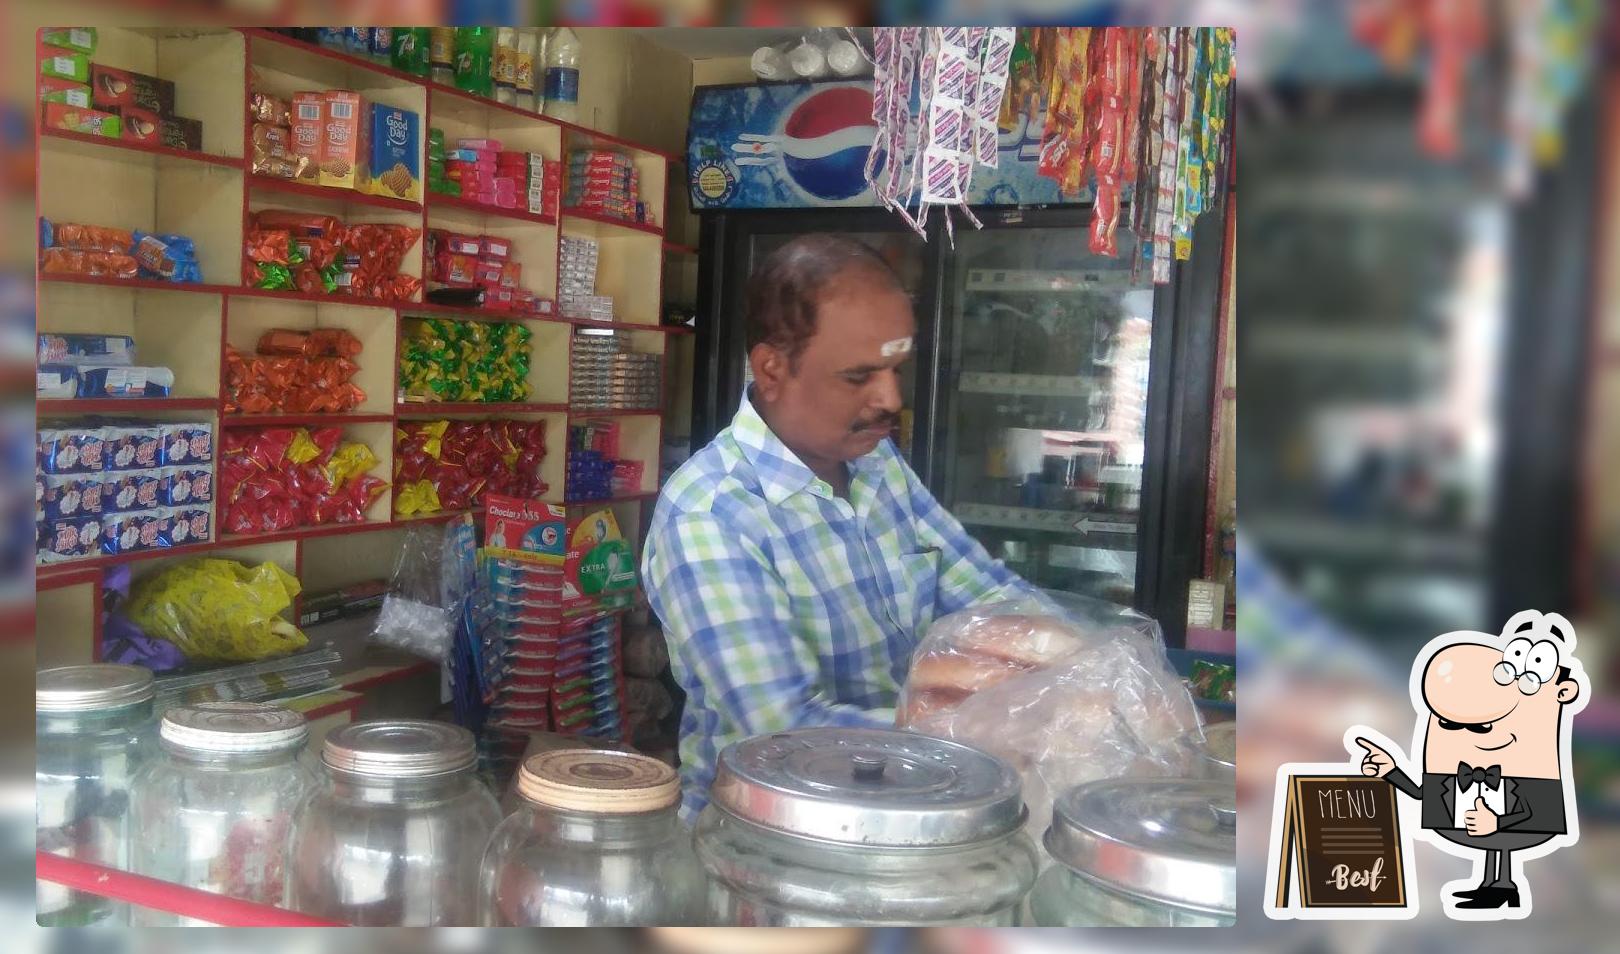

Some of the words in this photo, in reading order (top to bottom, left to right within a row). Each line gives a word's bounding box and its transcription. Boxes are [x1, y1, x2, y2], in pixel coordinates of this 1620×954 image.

[327, 123, 352, 134] Good
[387, 115, 408, 131] Good
[390, 126, 406, 140] Day
[692, 159, 711, 178] HELP
[581, 562, 606, 574] EXTRA
